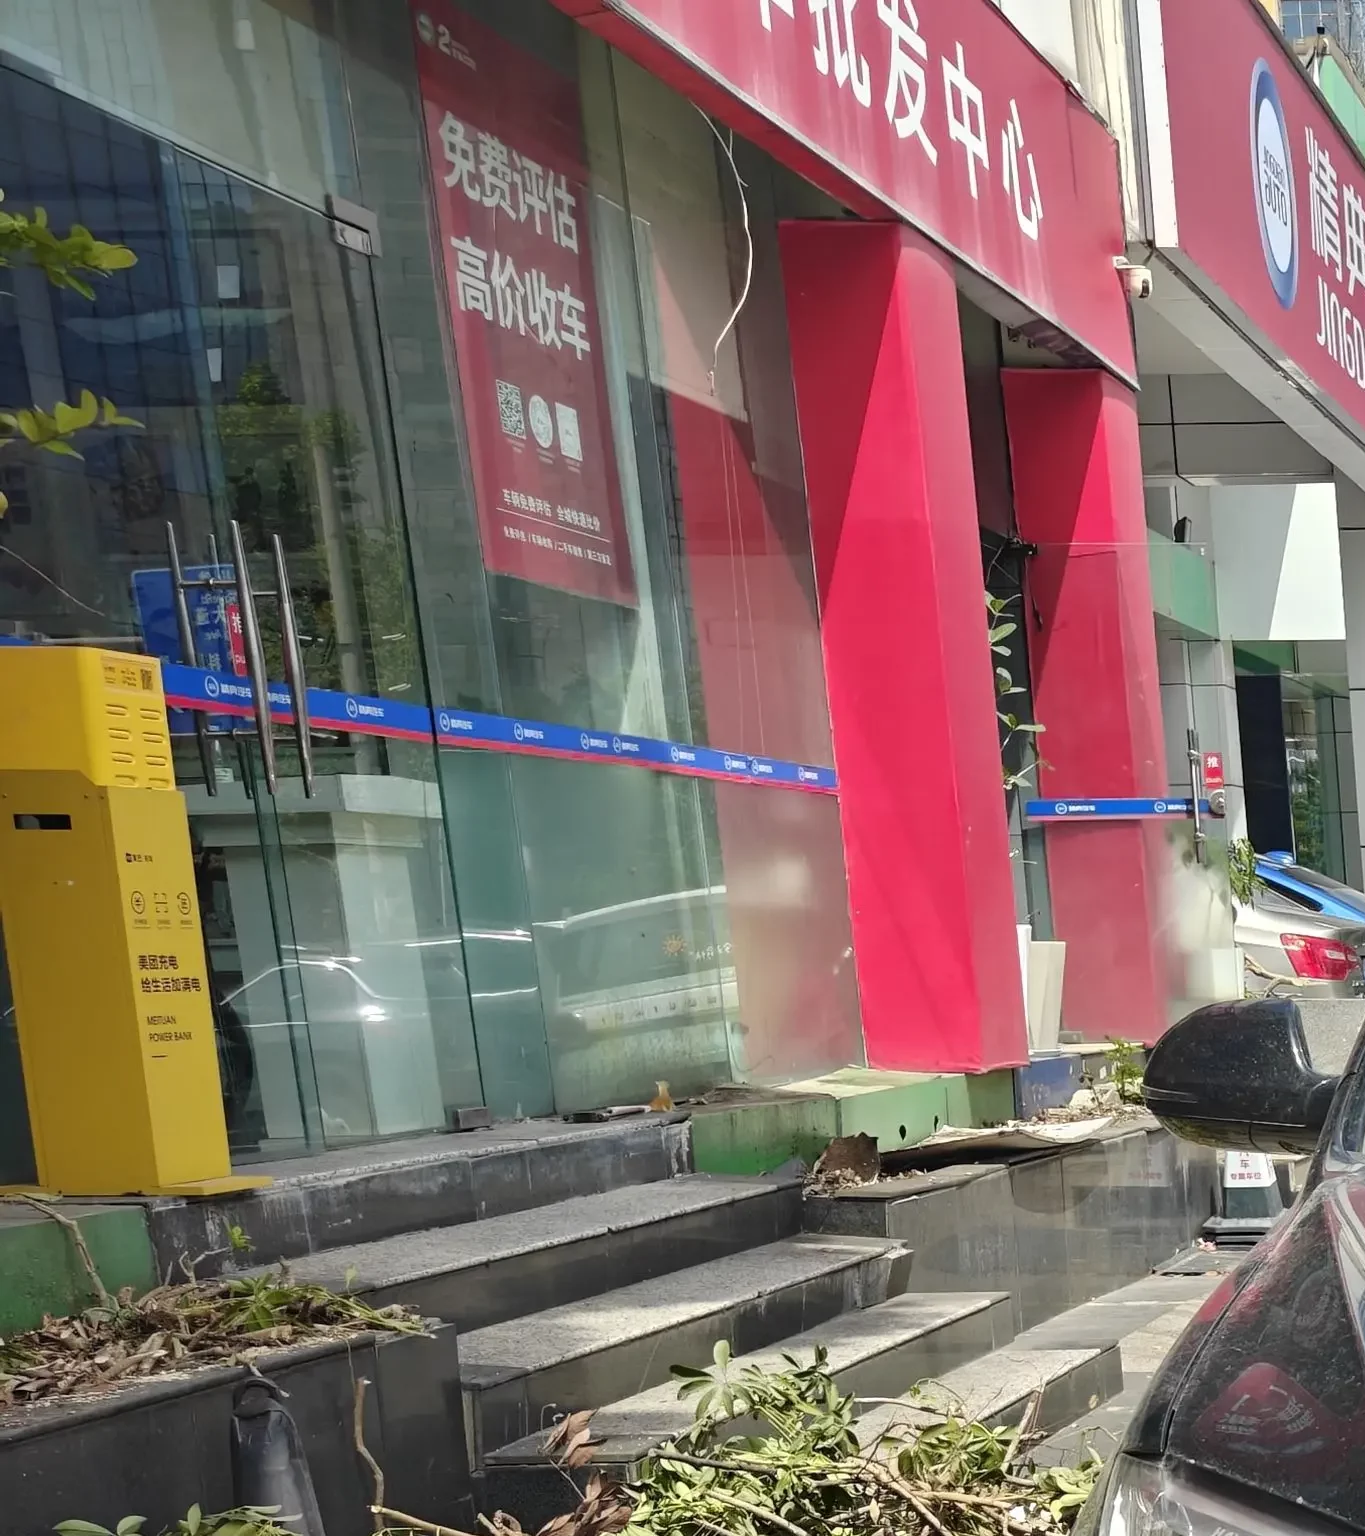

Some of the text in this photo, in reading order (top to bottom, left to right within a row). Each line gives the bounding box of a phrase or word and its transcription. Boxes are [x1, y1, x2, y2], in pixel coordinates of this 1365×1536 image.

[439, 110, 578, 254] 免费评估
[760, 0, 1043, 240] 批发中心
[451, 236, 591, 360] 高价收车
[138, 954, 179, 970] 美团充电
[174, 1032, 192, 1041] BANK
